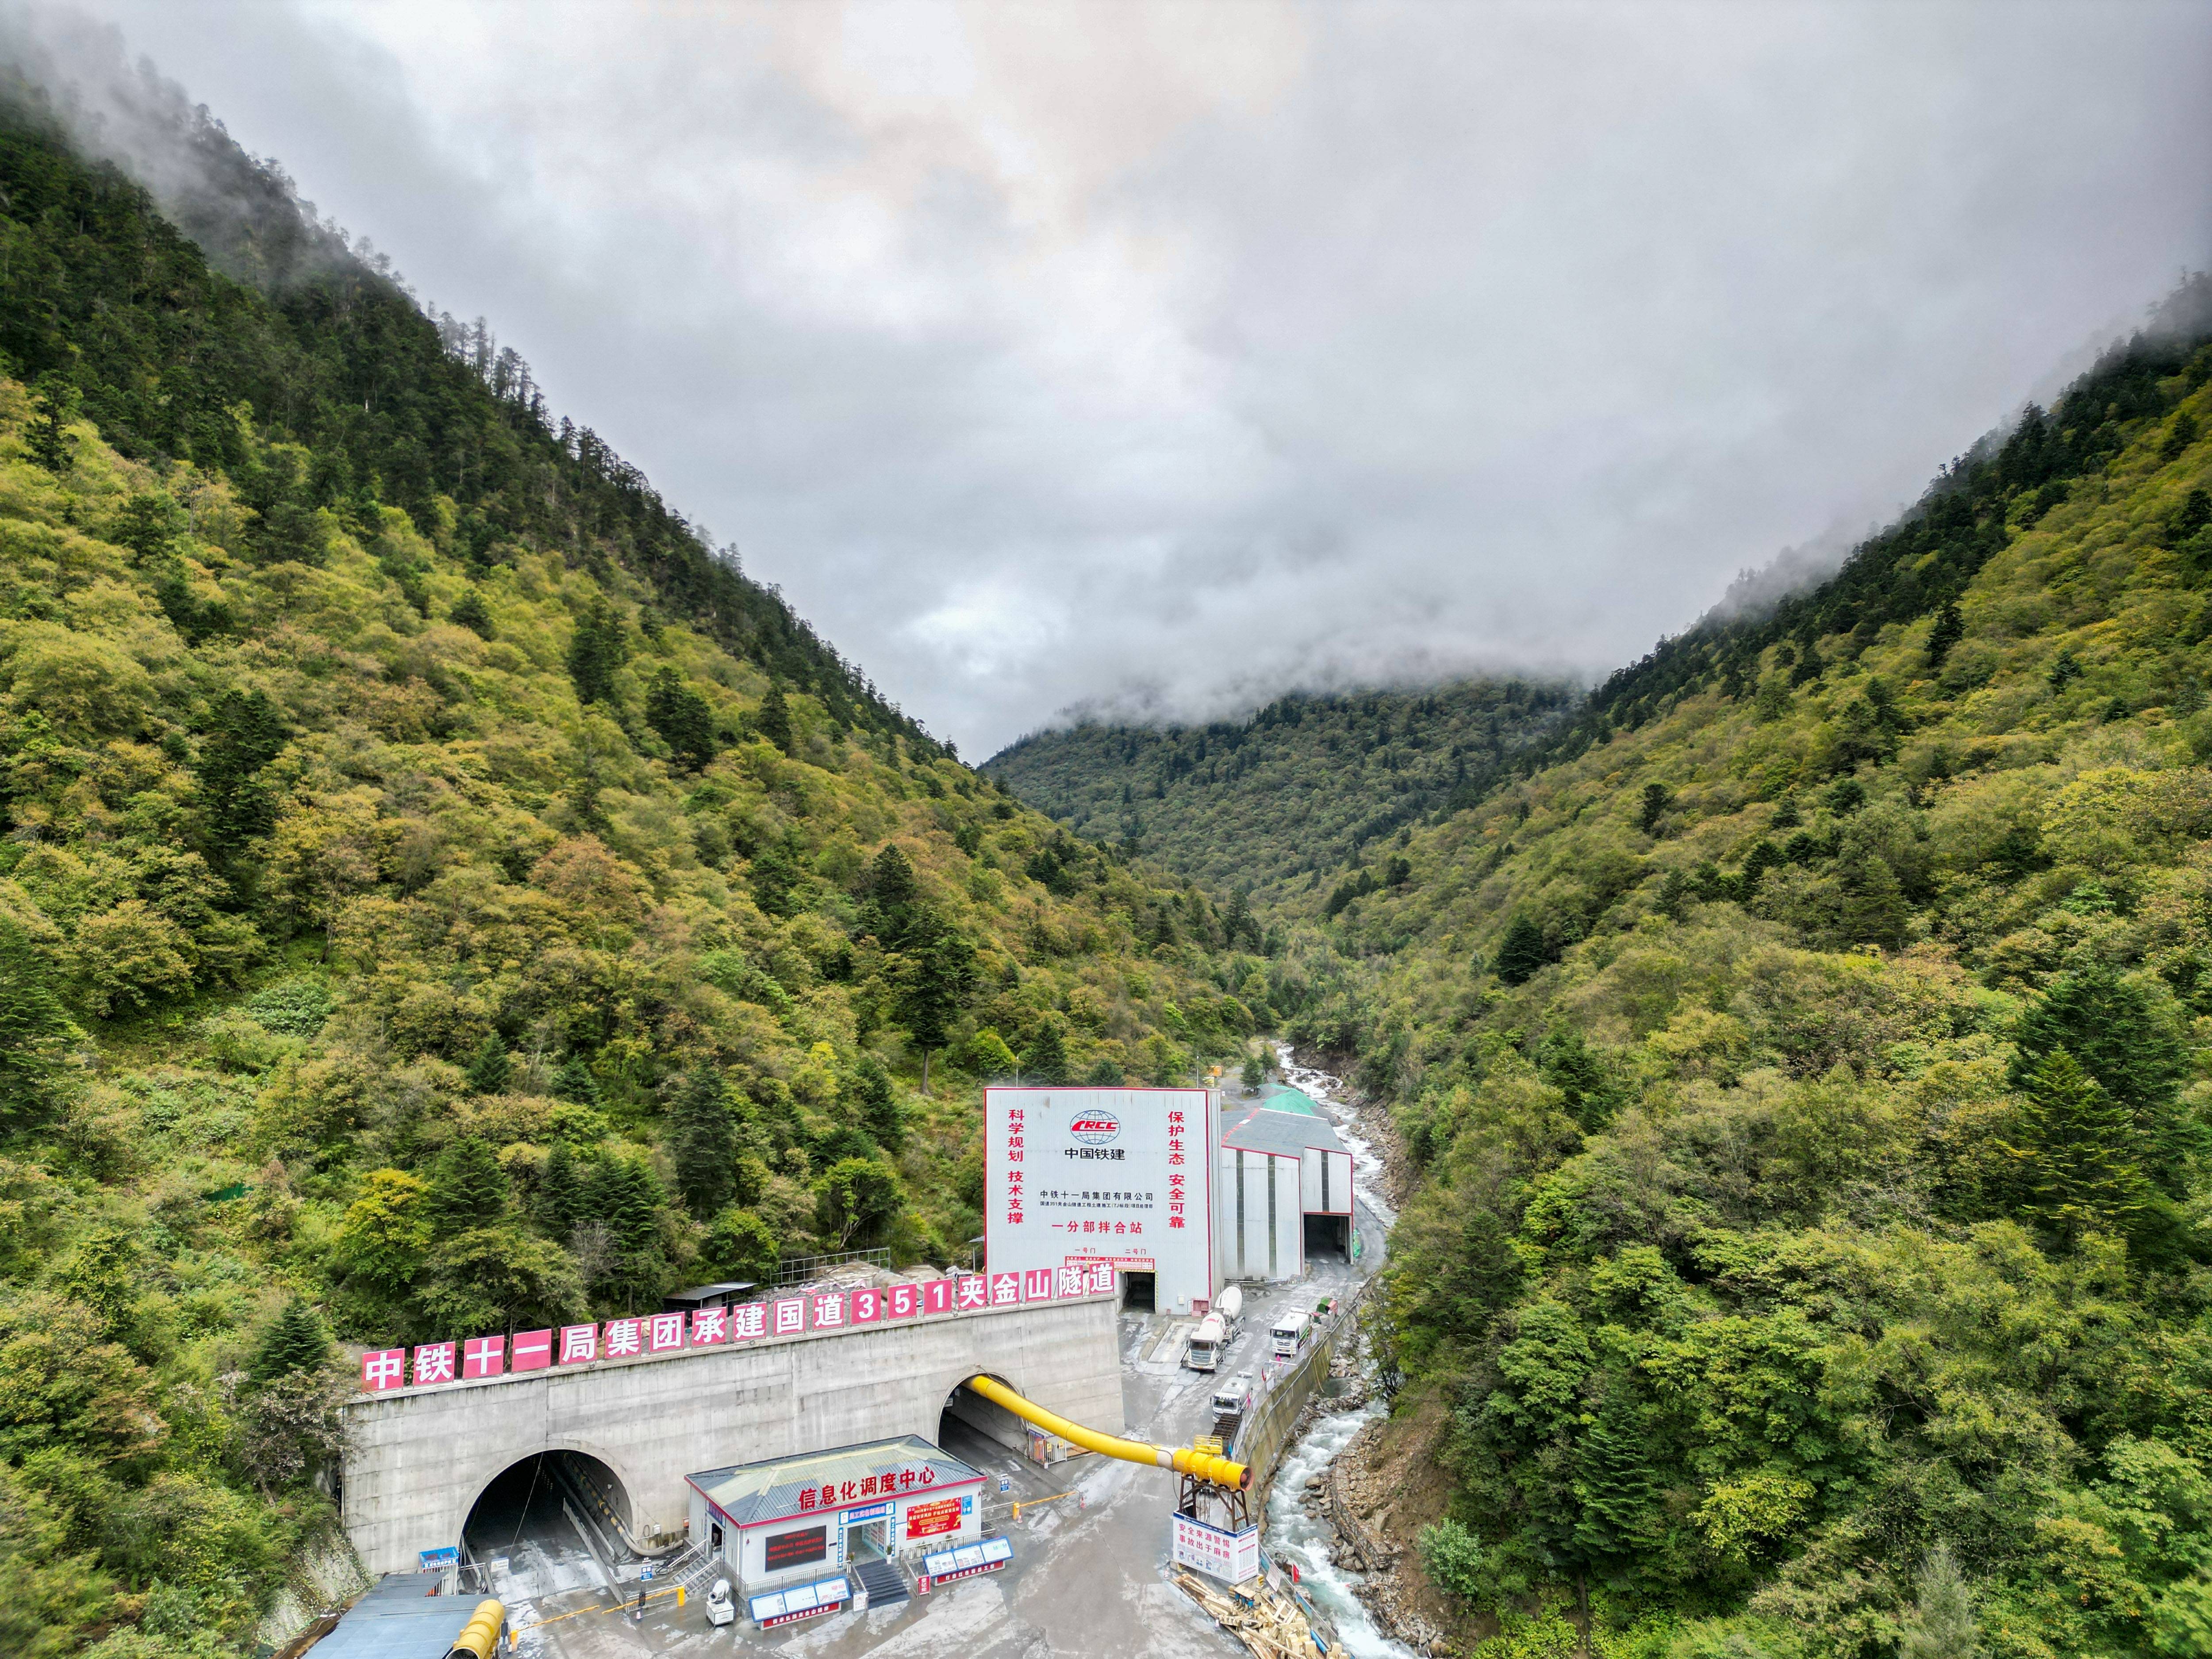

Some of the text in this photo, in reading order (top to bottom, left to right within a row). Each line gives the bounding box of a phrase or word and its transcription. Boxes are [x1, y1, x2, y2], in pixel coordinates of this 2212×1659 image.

[1071, 1121, 1118, 1131] CRCC
[1007, 1109, 1024, 1224] 科学规划 技术支撑
[1064, 1148, 1125, 1160] 中国铁建
[1168, 1111, 1185, 1228] 保护生态 安全可靠
[1040, 1190, 1153, 1201] 中铁十一局集团有限公司
[1052, 1220, 1142, 1234] 一分部拌合站
[365, 1263, 1114, 1389] 中铁十一局集团承建国道351夹金山隧道
[799, 1466, 935, 1510] 信息化调度中心
[1179, 1523, 1230, 1548] 安全来源警惕
[1179, 1534, 1230, 1560] 事故出于麻痹
